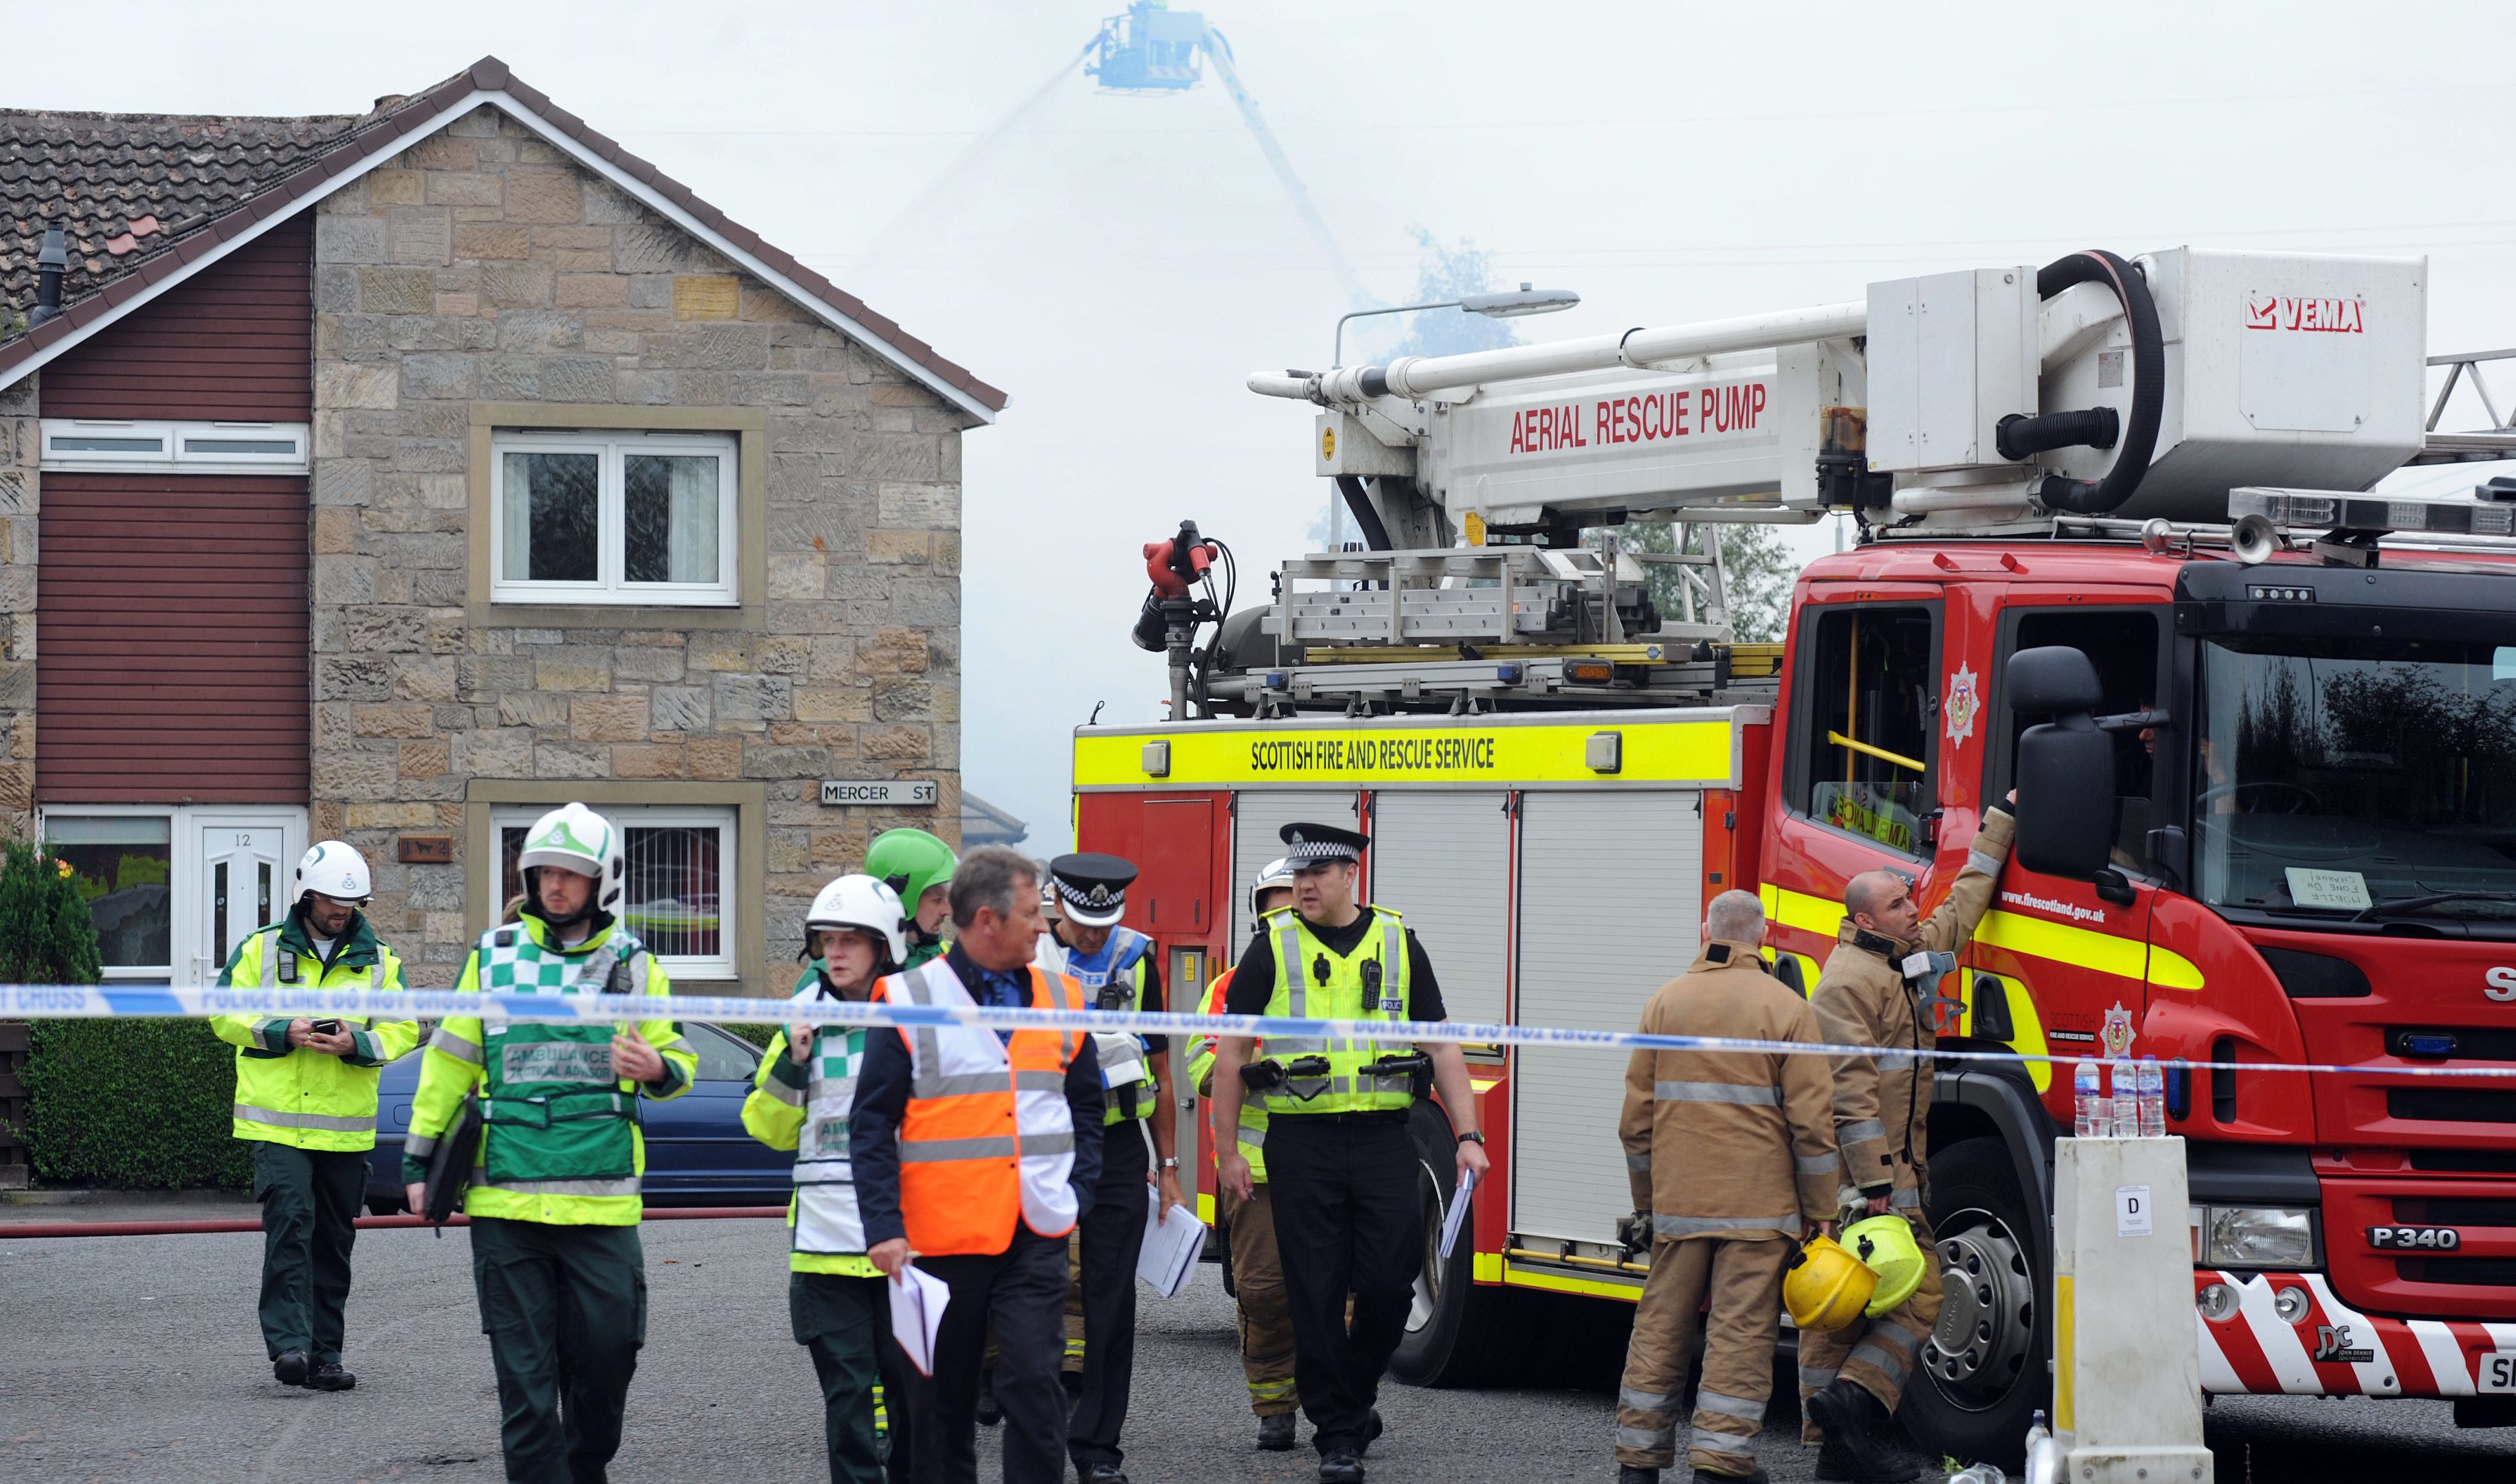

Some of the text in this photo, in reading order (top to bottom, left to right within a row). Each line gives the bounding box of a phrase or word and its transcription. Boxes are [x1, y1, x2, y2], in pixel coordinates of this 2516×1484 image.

[2280, 297, 2363, 333] VEMA
[1510, 383, 1766, 453] AERIAL RESCUE PUMP
[1251, 738, 1494, 770] SCOTTISH FIRE AND RESCUE SERVICE
[825, 786, 934, 800] MERCER ST
[236, 834, 251, 846] 12
[438, 840, 447, 857] 2
[2329, 884, 2359, 893] FONE
[2001, 890, 2105, 923] www.firescotland.gov.uk
[2312, 893, 2361, 903] MOBILE
[2050, 1012, 2095, 1029] SCOTTISH
[510, 1048, 610, 1064] AMBULANCE
[2128, 1198, 2139, 1213] D
[2374, 1228, 2457, 1248] P 340
[2316, 1325, 2352, 1360] JDC
